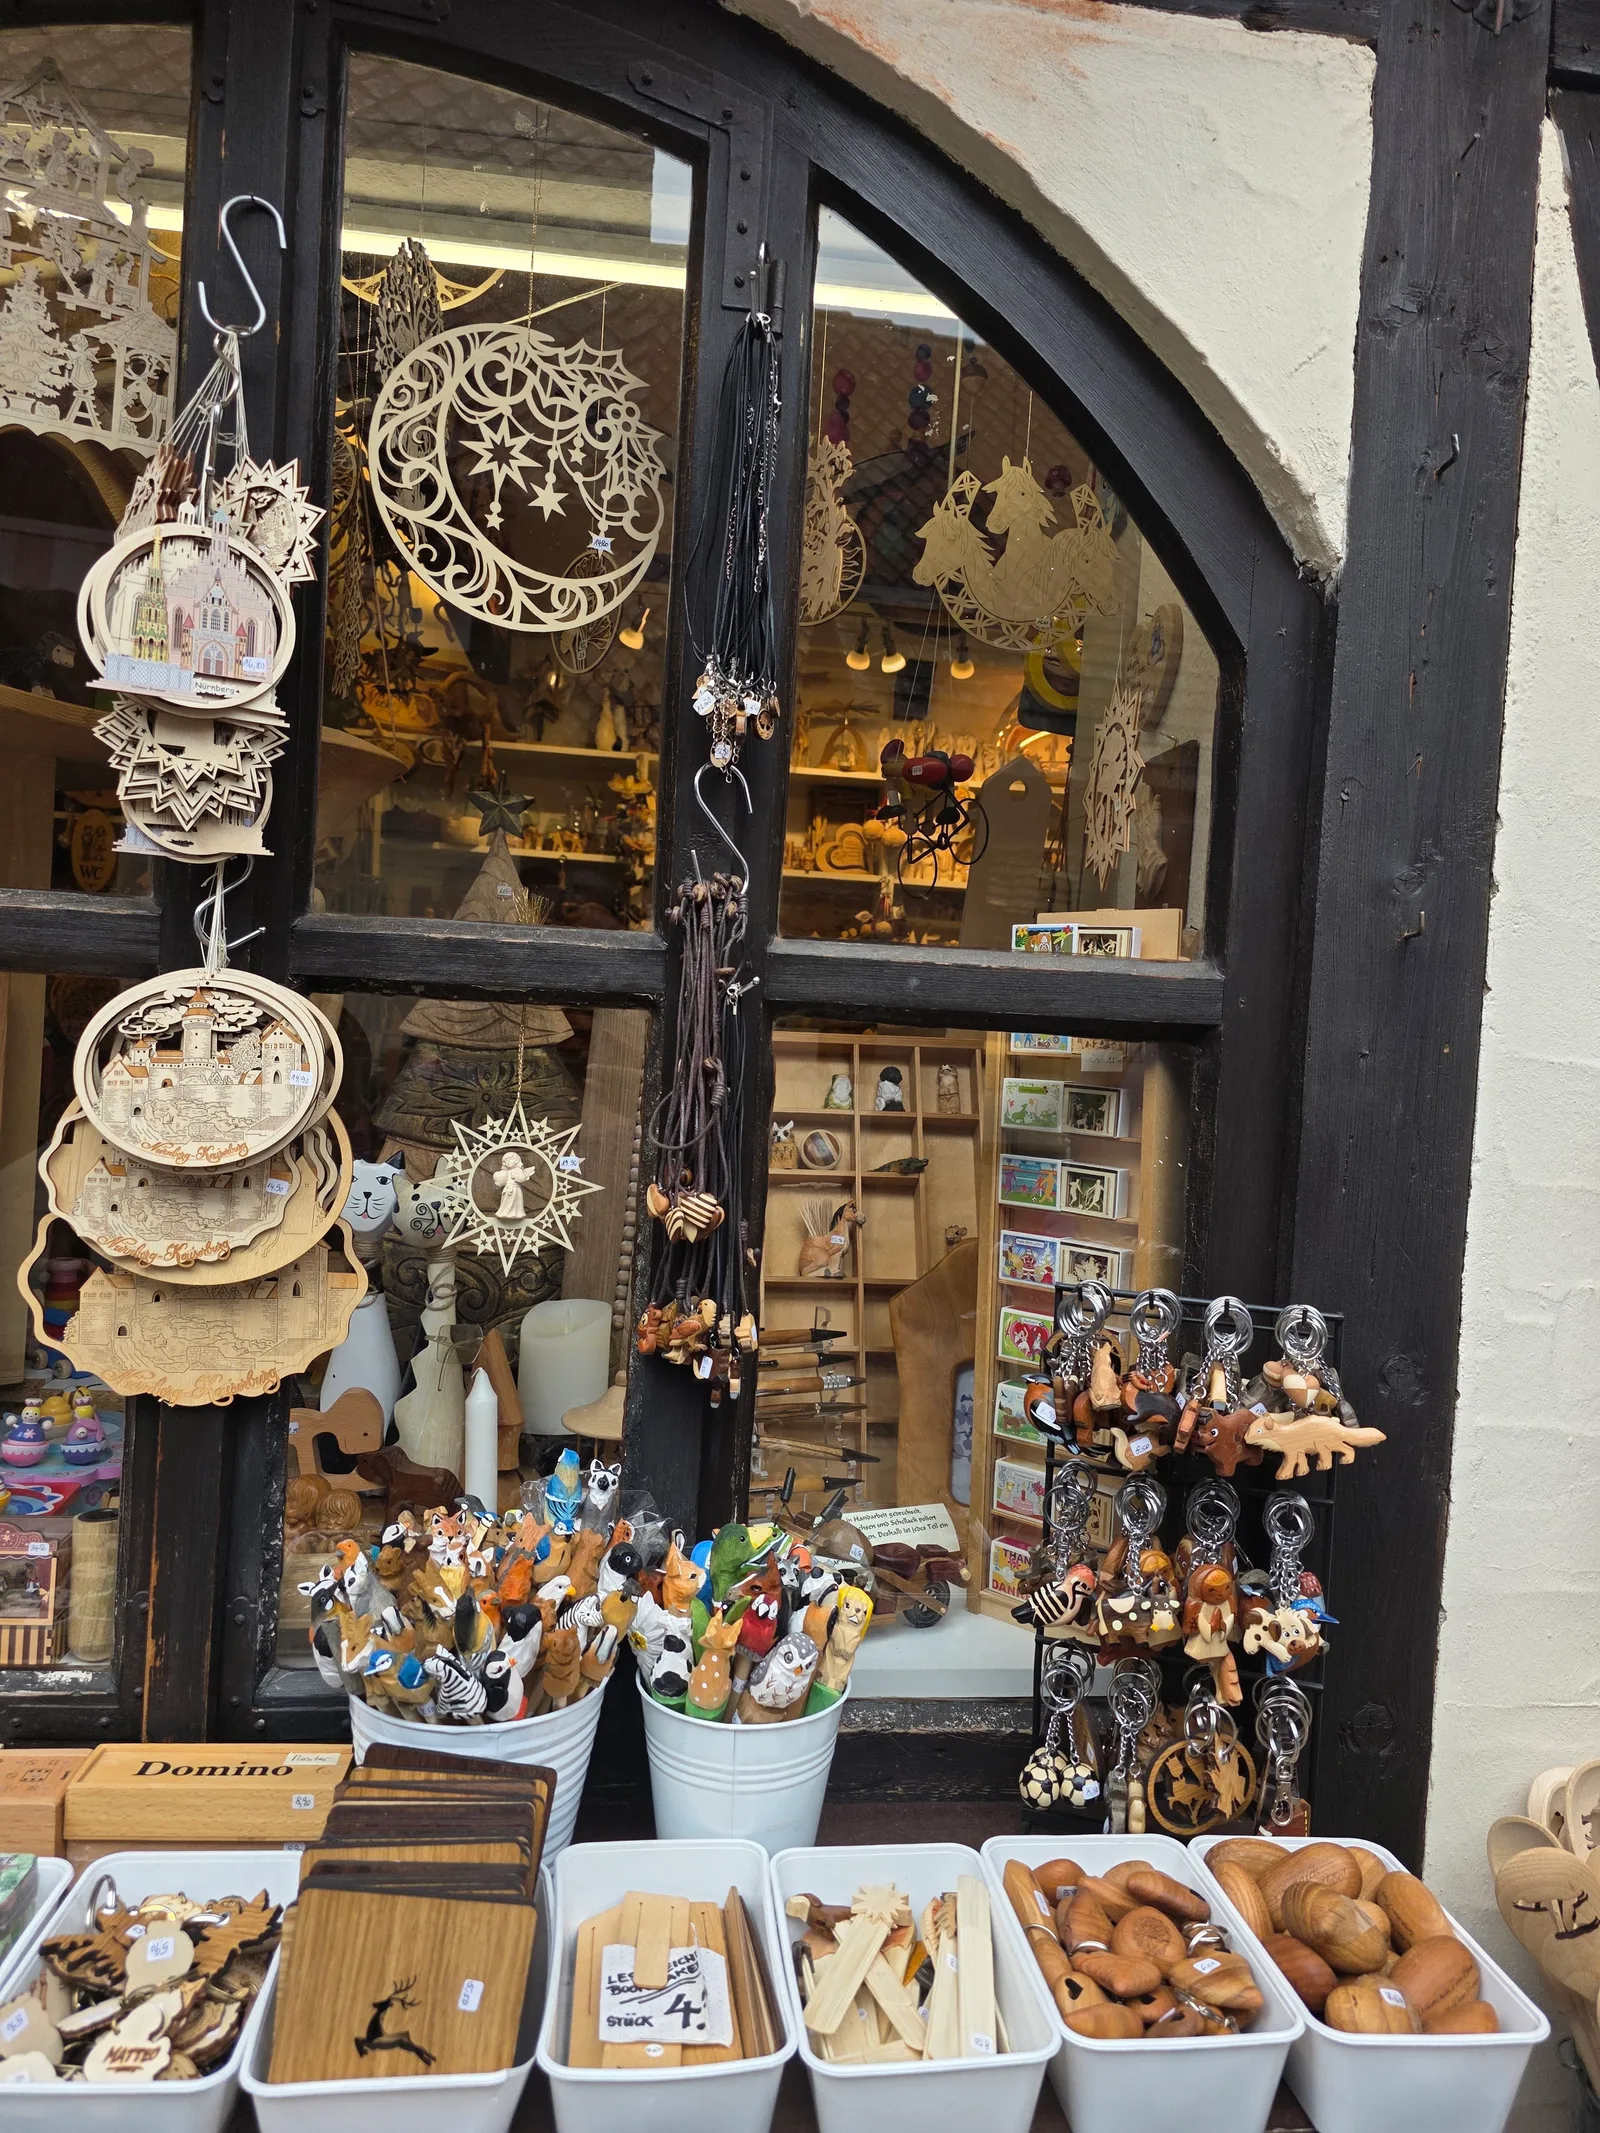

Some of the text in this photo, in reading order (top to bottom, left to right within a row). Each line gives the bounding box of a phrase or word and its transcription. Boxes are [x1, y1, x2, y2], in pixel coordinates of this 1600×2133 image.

[194, 681, 236, 696] Nürnberg
[78, 864, 105, 881] WC
[853, 1512, 888, 1522] Handarbeit
[858, 1514, 937, 1531] chsen und Schellack poliert
[878, 1528, 902, 1538] Deshalb
[902, 1526, 911, 1534] ist
[911, 1524, 927, 1534] jedes
[928, 1522, 939, 1530] Teil
[939, 1521, 949, 1529] ein
[1002, 1548, 1031, 1566] THAN
[133, 1760, 294, 1777] Domino
